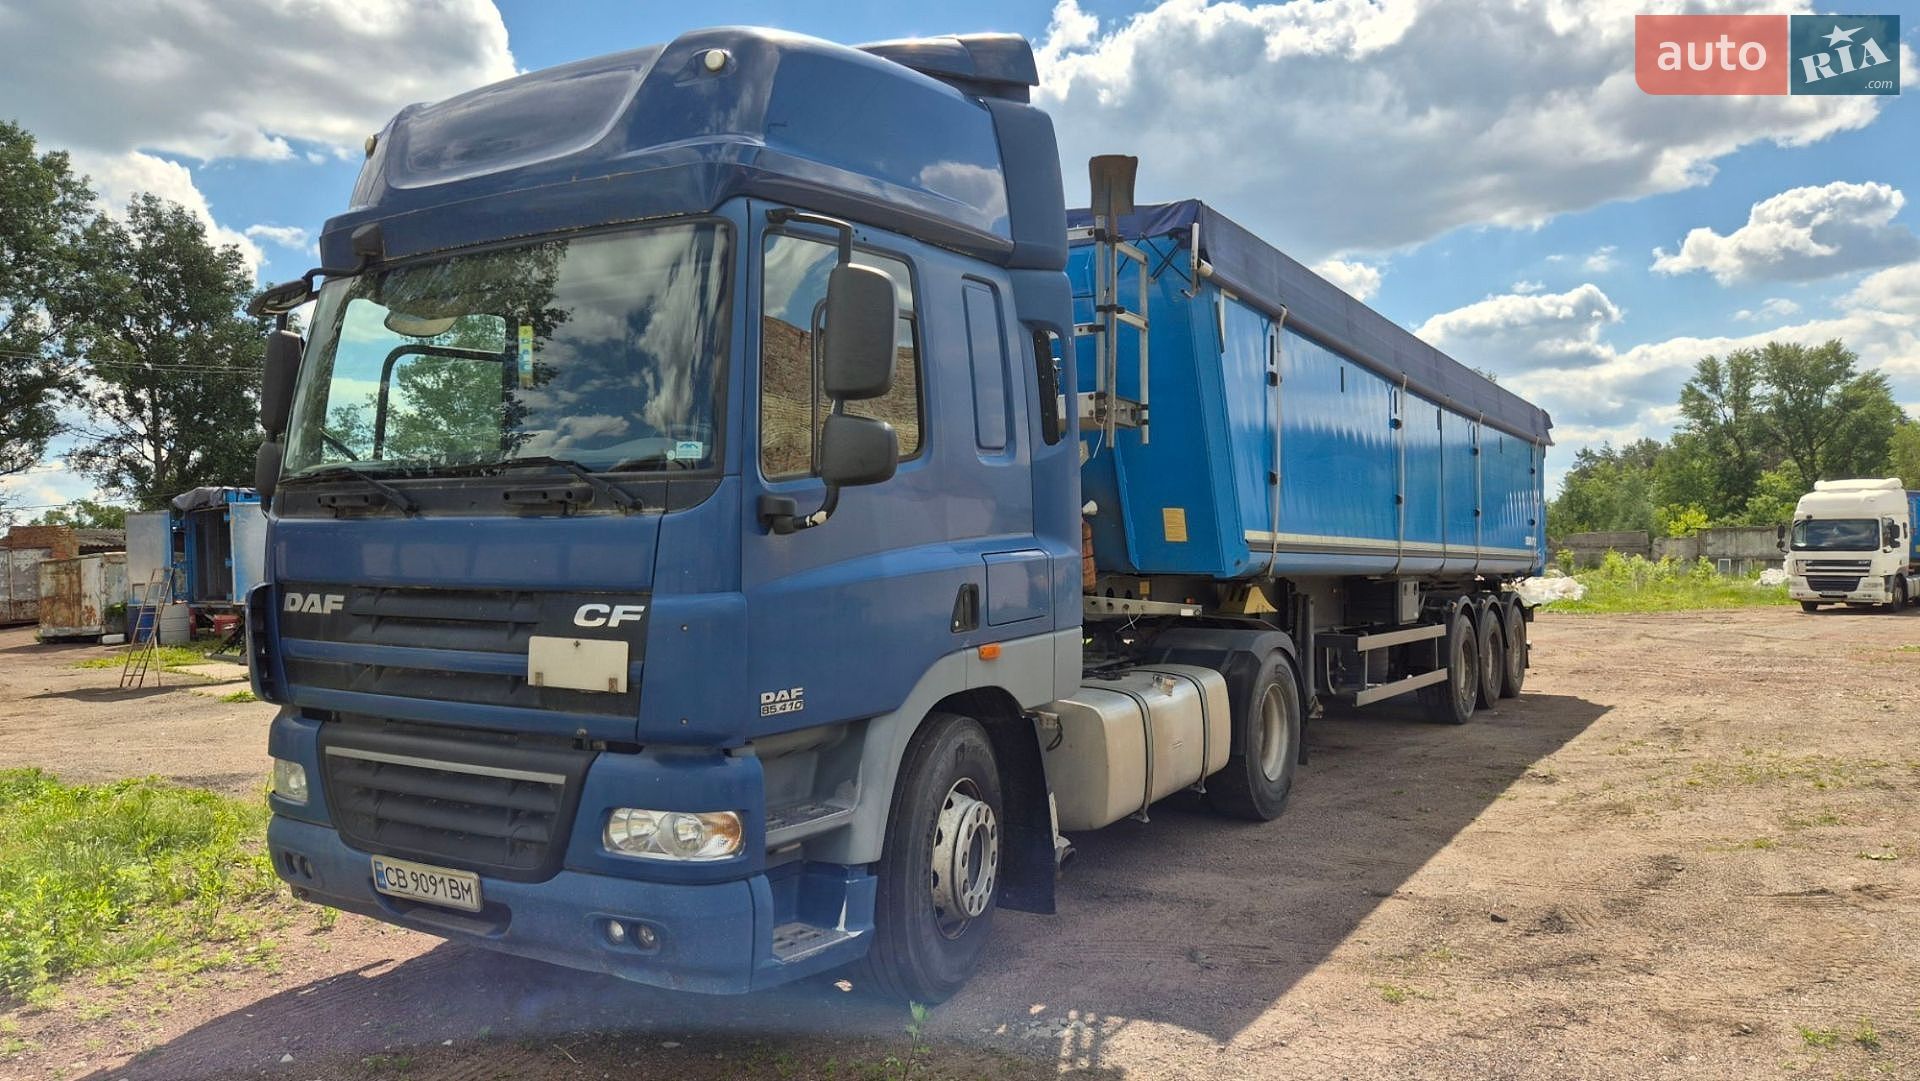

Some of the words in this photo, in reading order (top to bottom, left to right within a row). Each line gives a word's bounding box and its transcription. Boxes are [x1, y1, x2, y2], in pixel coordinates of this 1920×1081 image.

[283, 592, 345, 615] DAF
[573, 603, 645, 628] CF
[761, 688, 804, 704] DAF
